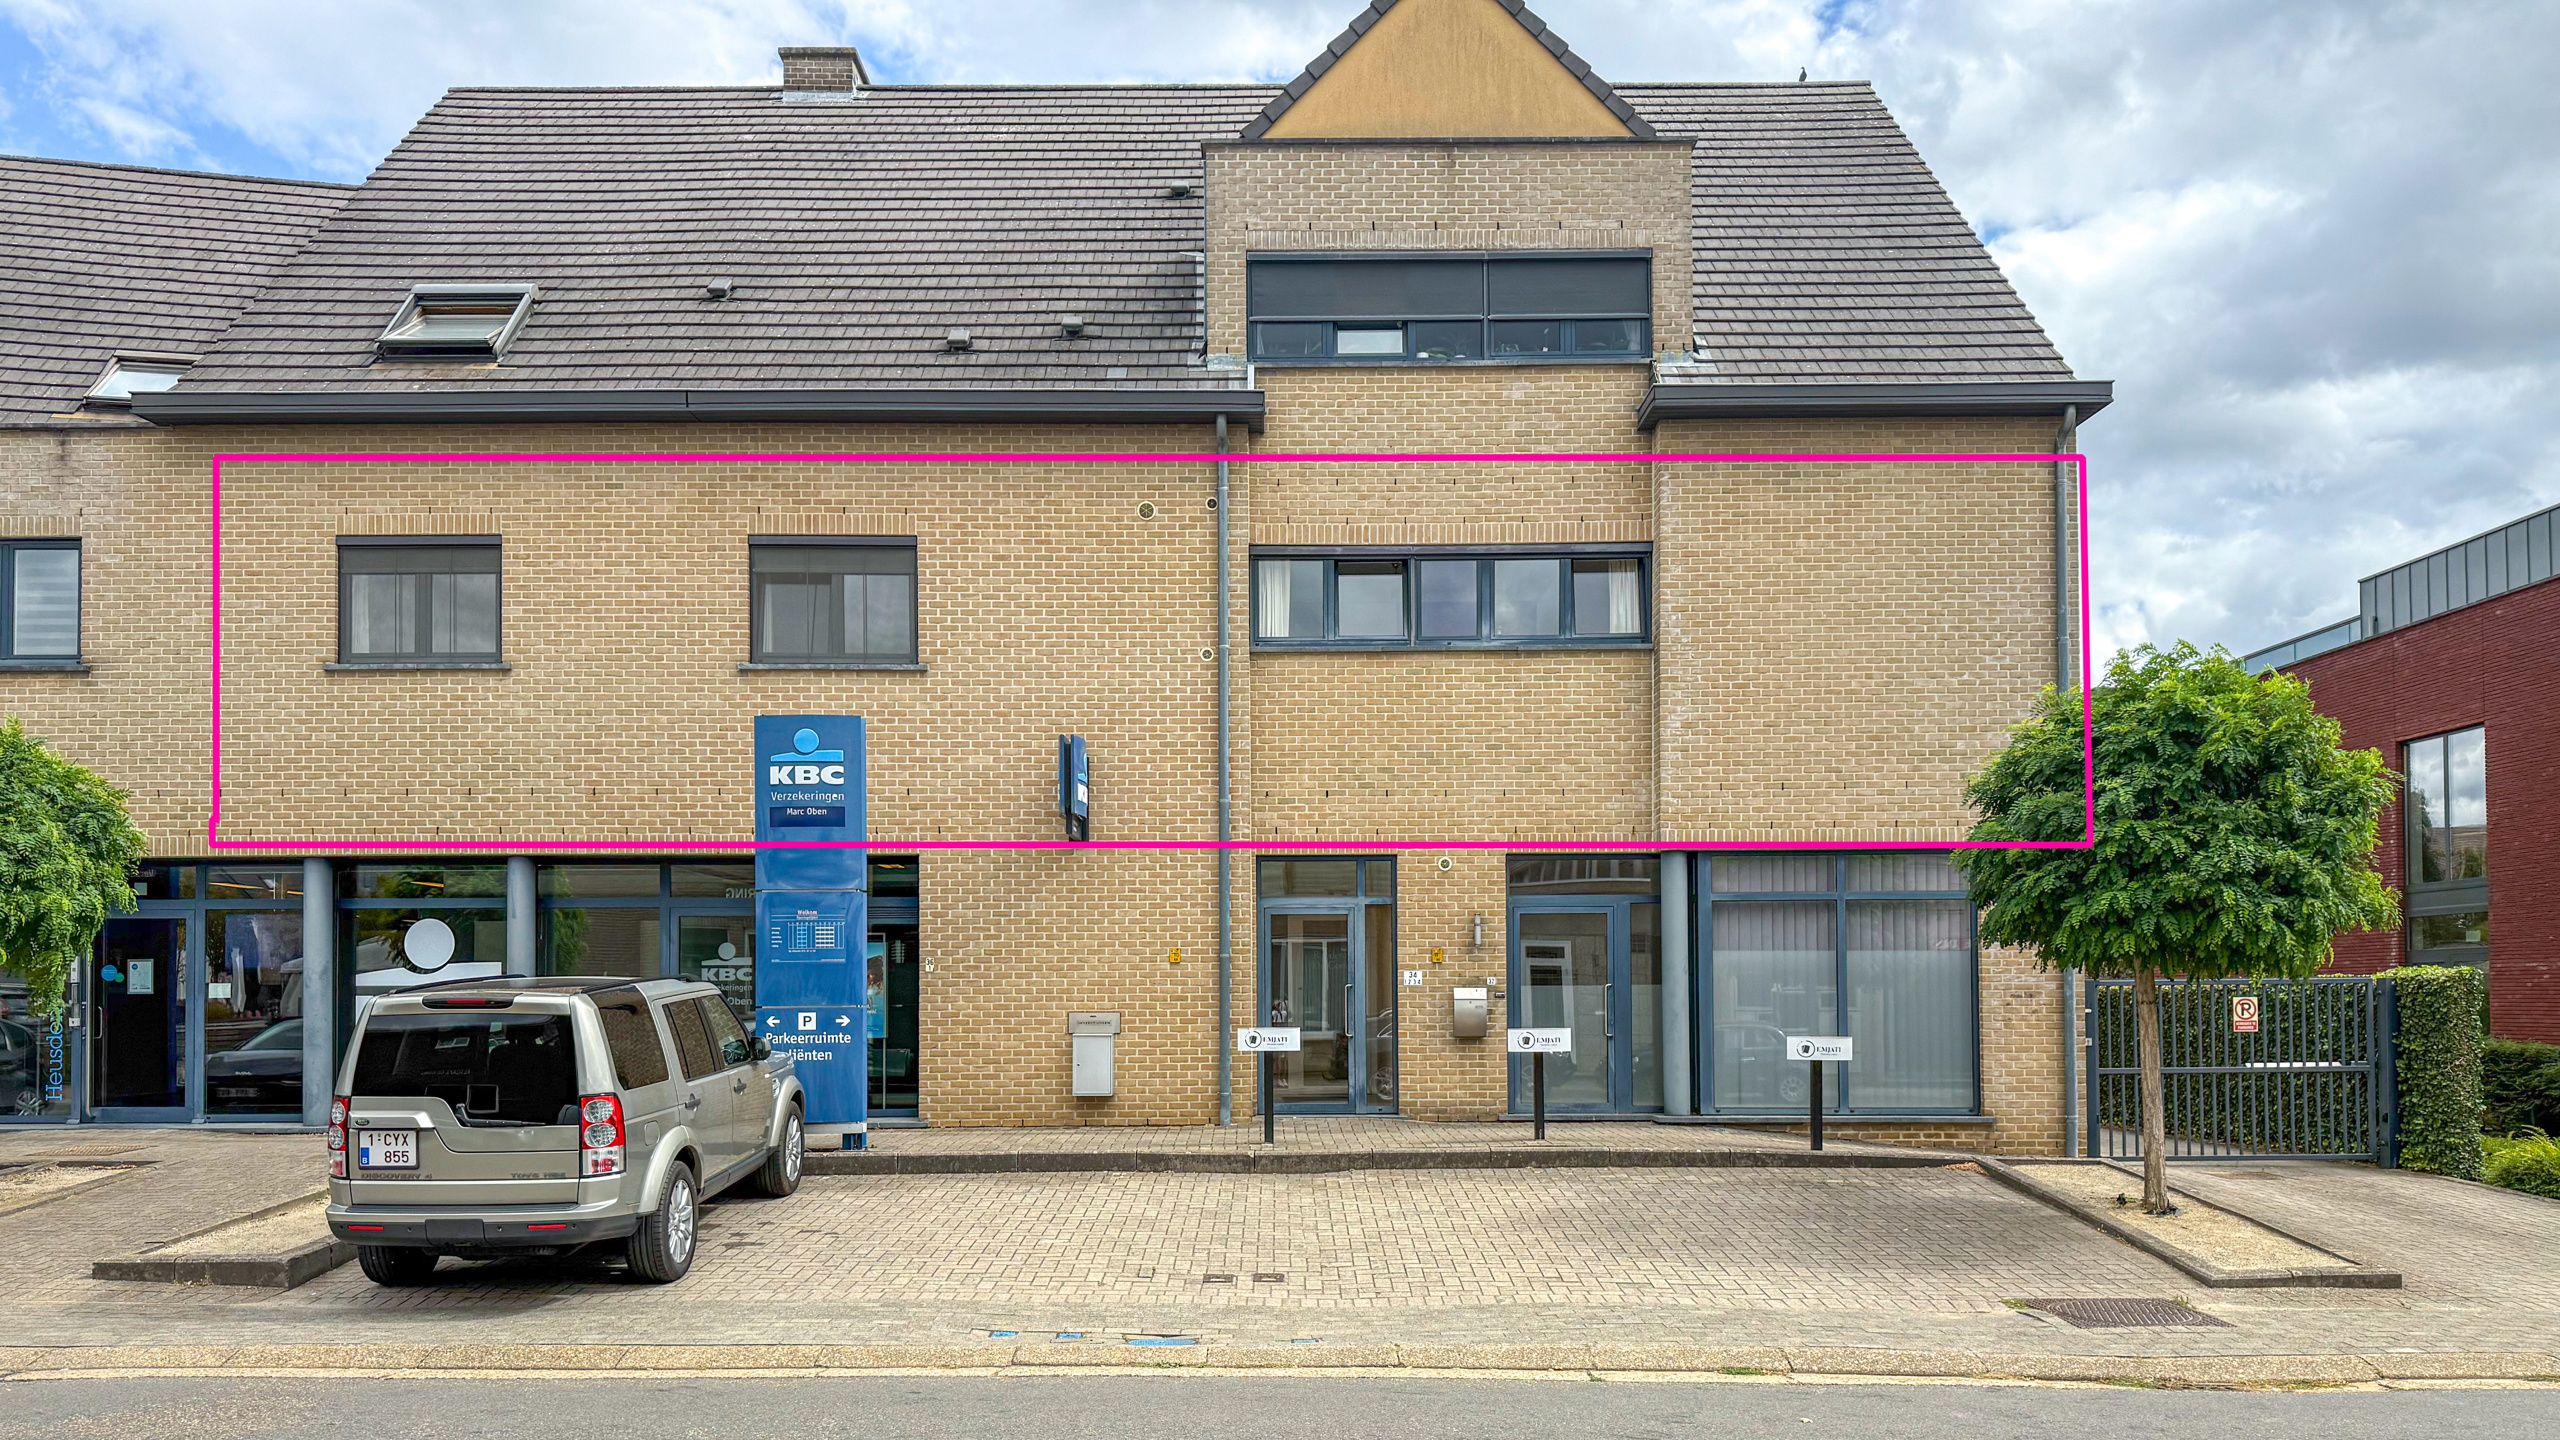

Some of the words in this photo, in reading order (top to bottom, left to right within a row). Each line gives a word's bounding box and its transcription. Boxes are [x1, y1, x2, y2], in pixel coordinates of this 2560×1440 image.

[769, 765, 845, 785] KBC
[770, 790, 845, 803] Verzekeringen
[786, 807, 805, 816] Marc
[806, 807, 827, 816] Oben
[701, 967, 753, 981] KBC
[803, 1015, 812, 1027] P
[765, 1031, 852, 1044] Parkeerruimte
[788, 1048, 833, 1061] liënten
[384, 1150, 410, 1164] 855
